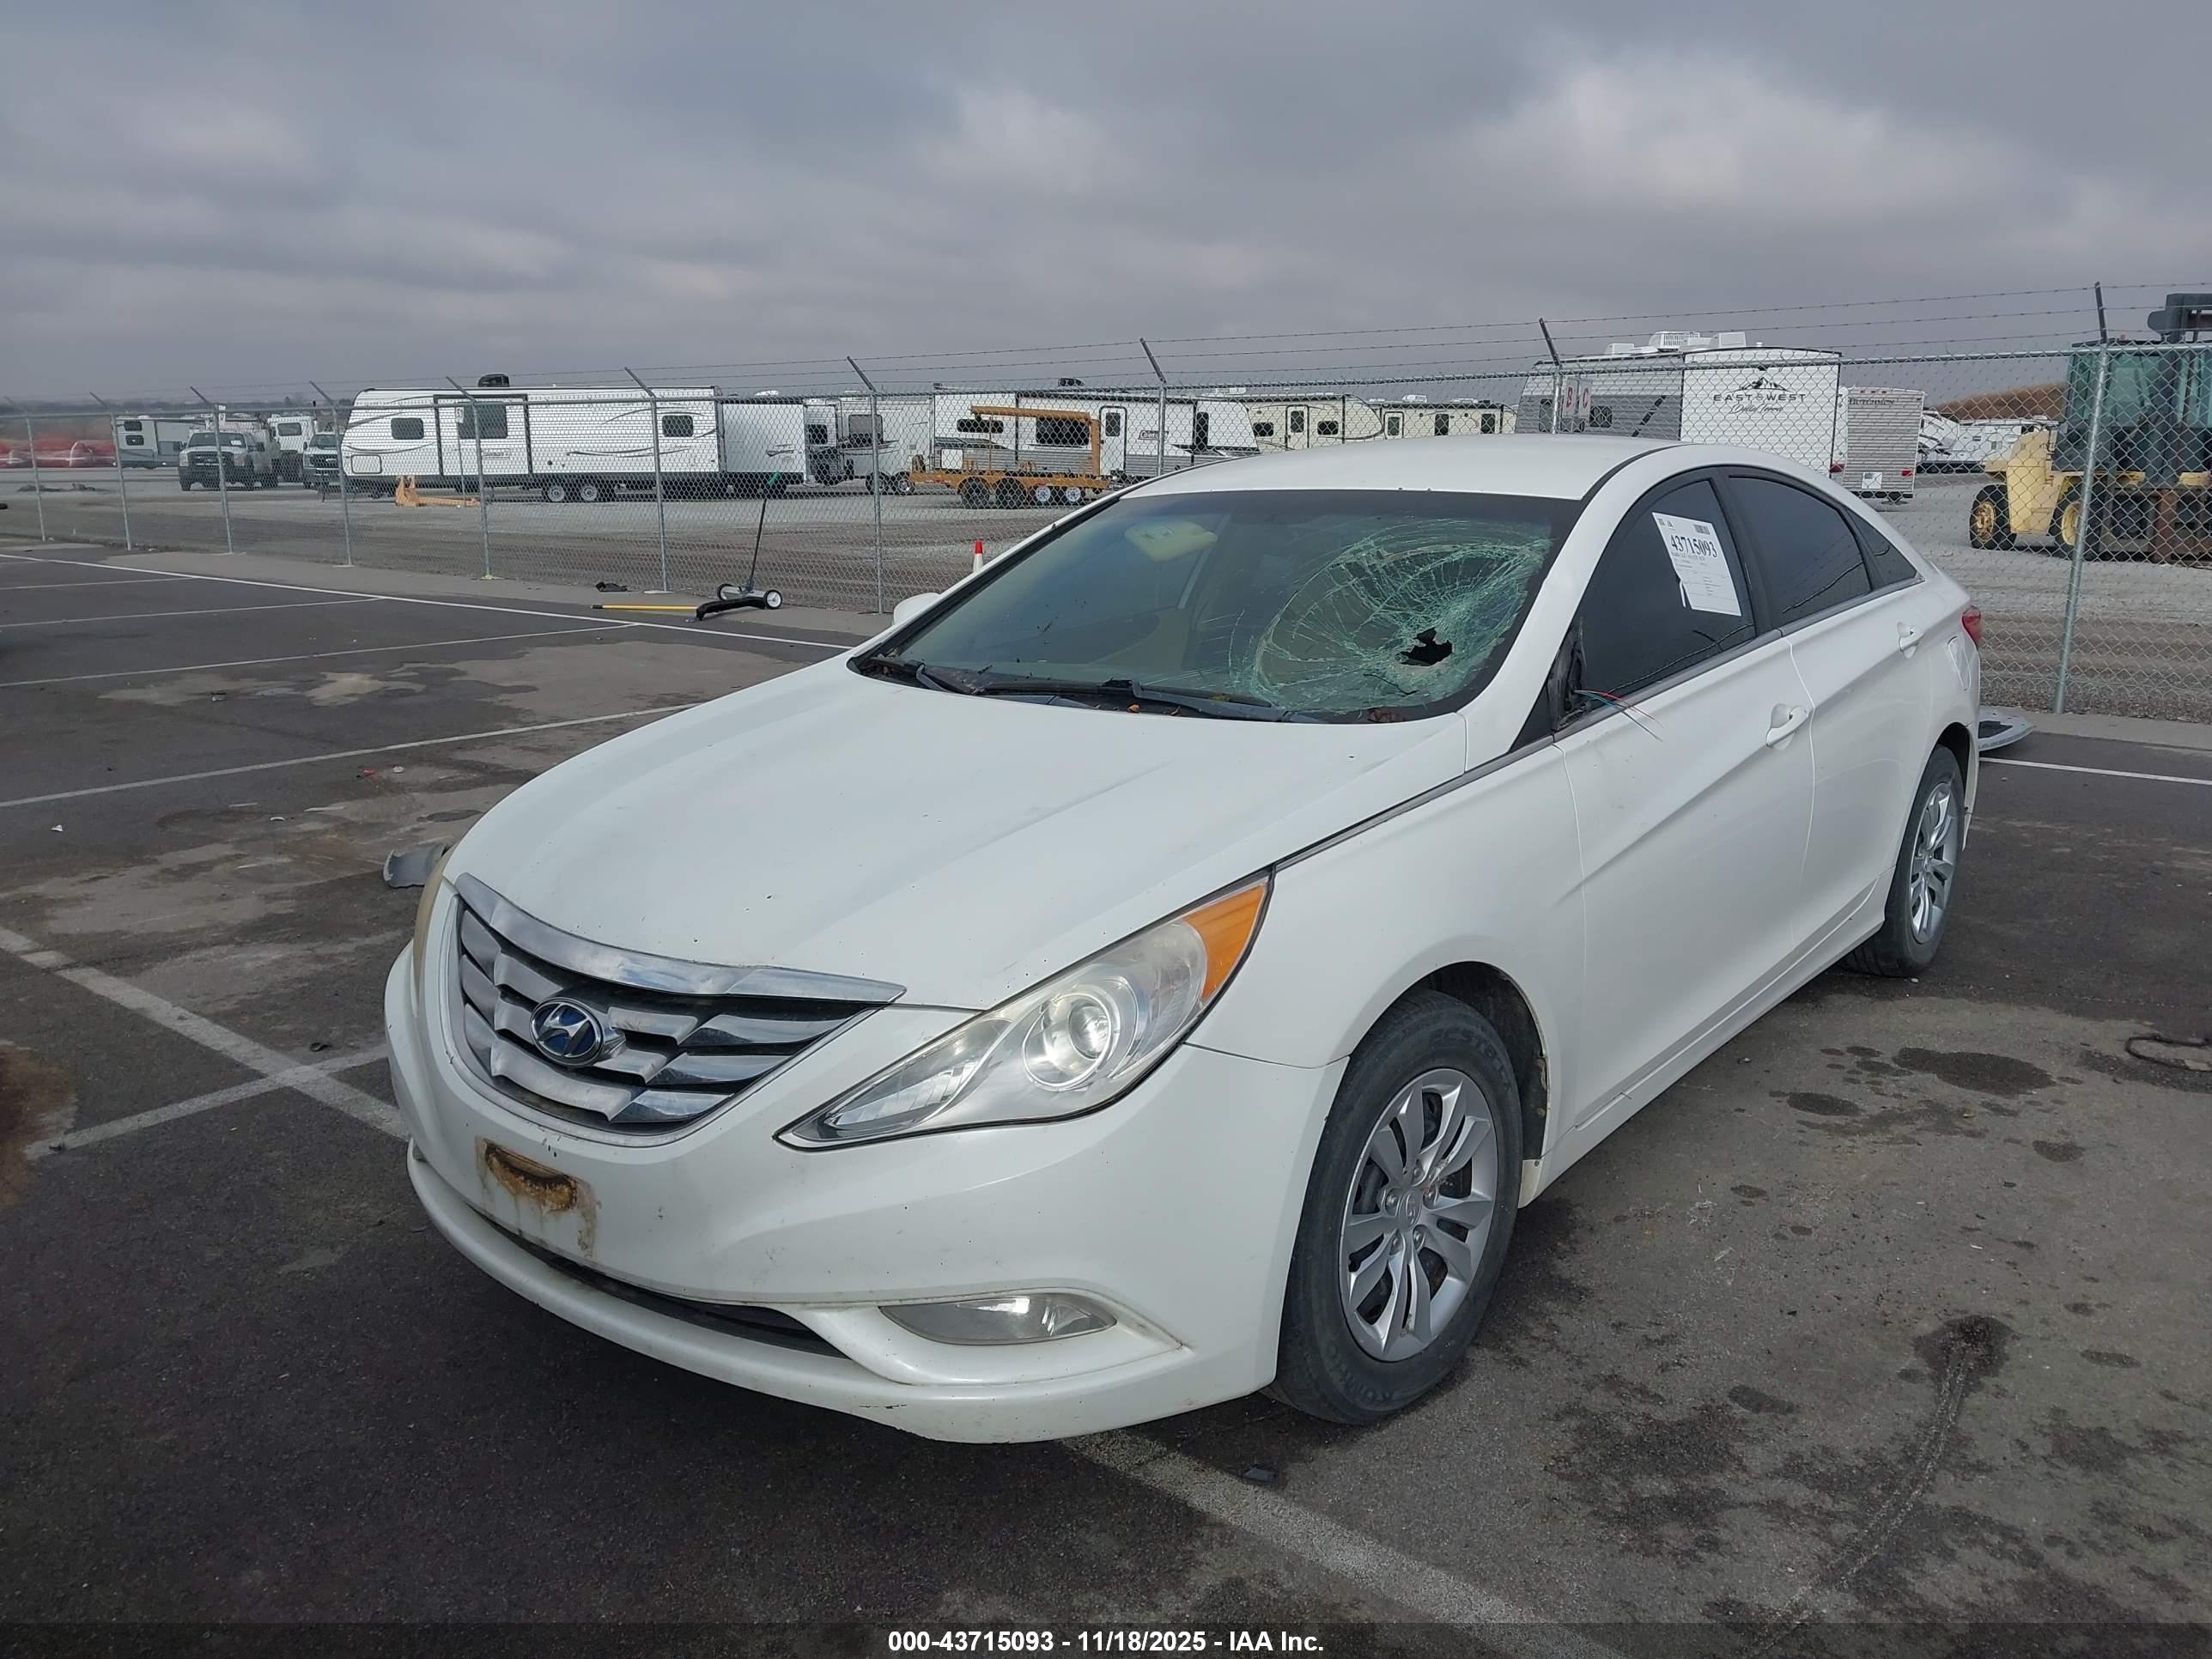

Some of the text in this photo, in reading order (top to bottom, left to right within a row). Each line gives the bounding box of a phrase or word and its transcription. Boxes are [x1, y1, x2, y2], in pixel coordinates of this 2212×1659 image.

[1713, 393, 1753, 402] EAST
[1765, 393, 1806, 402] WEST
[1671, 535, 1718, 558] 43715093
